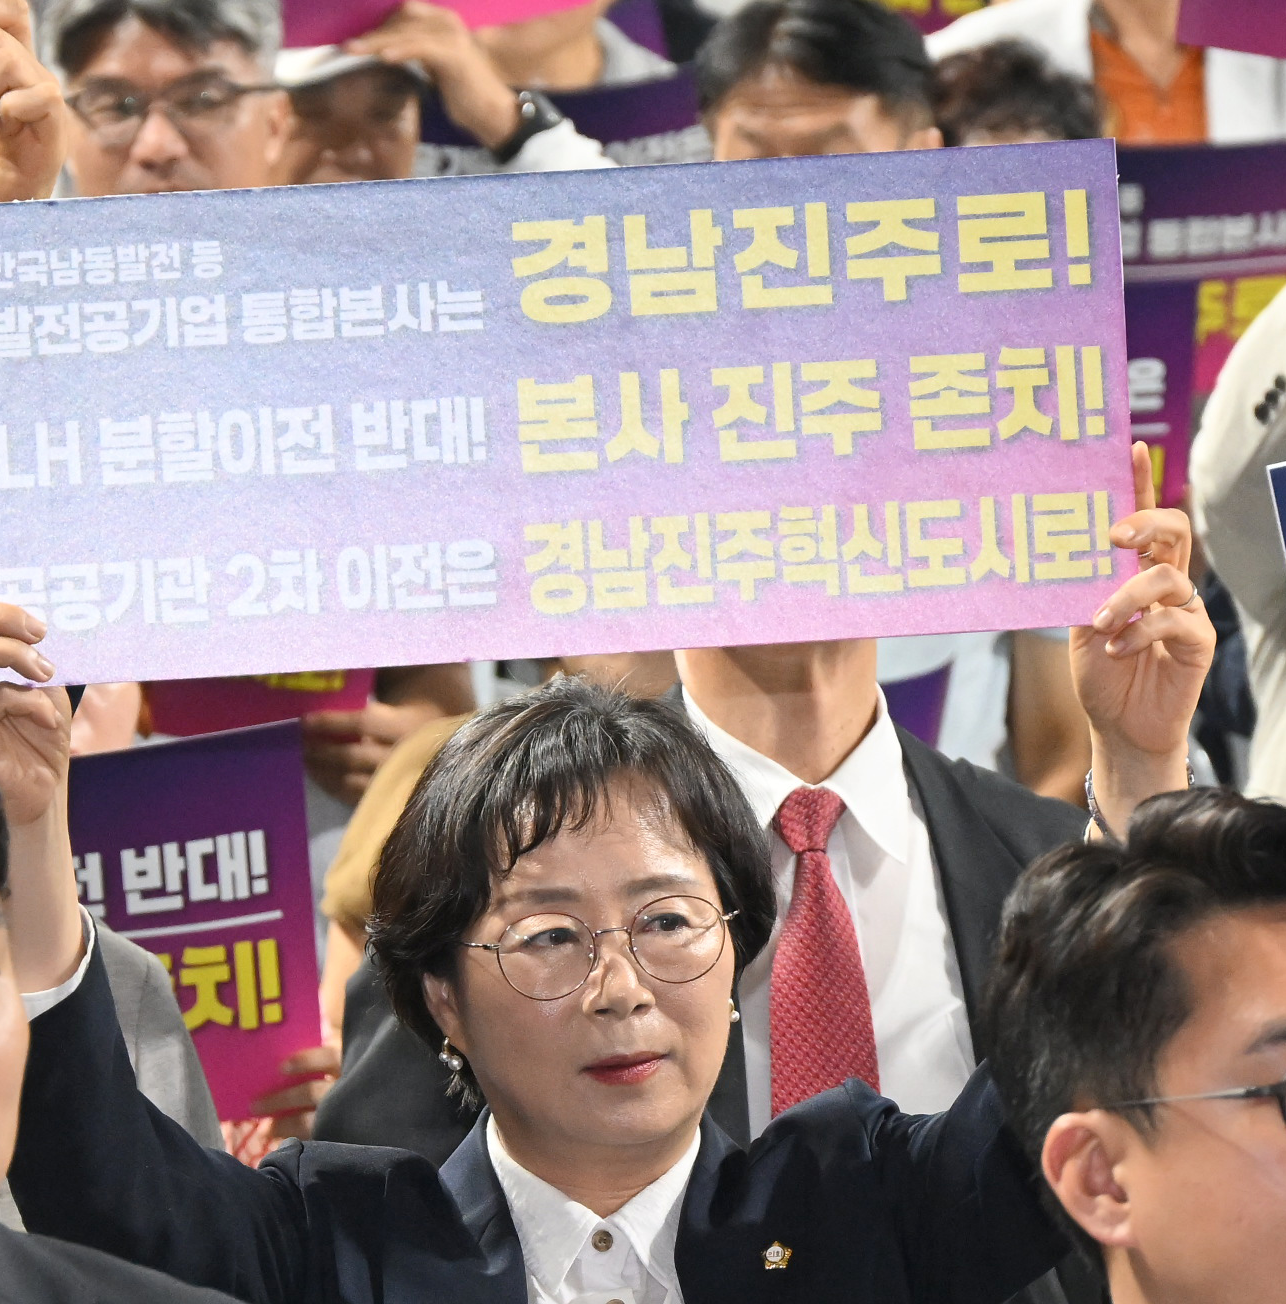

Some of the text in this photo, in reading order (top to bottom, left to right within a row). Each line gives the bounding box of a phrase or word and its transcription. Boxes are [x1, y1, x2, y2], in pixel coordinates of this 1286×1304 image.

[190, 241, 224, 279] 등
[510, 189, 1092, 323] 경남진주로!
[243, 281, 484, 348] 통합본사는
[99, 404, 335, 487] 분할이전
[352, 397, 486, 472] 반대!
[517, 346, 1106, 473] 본사 진주 존치!
[226, 549, 322, 619] 2차
[336, 543, 497, 612] 이전은
[523, 491, 1113, 615] 경남진주혁신도시로!
[120, 829, 269, 916] 반대!
[158, 938, 283, 1030] 치!
